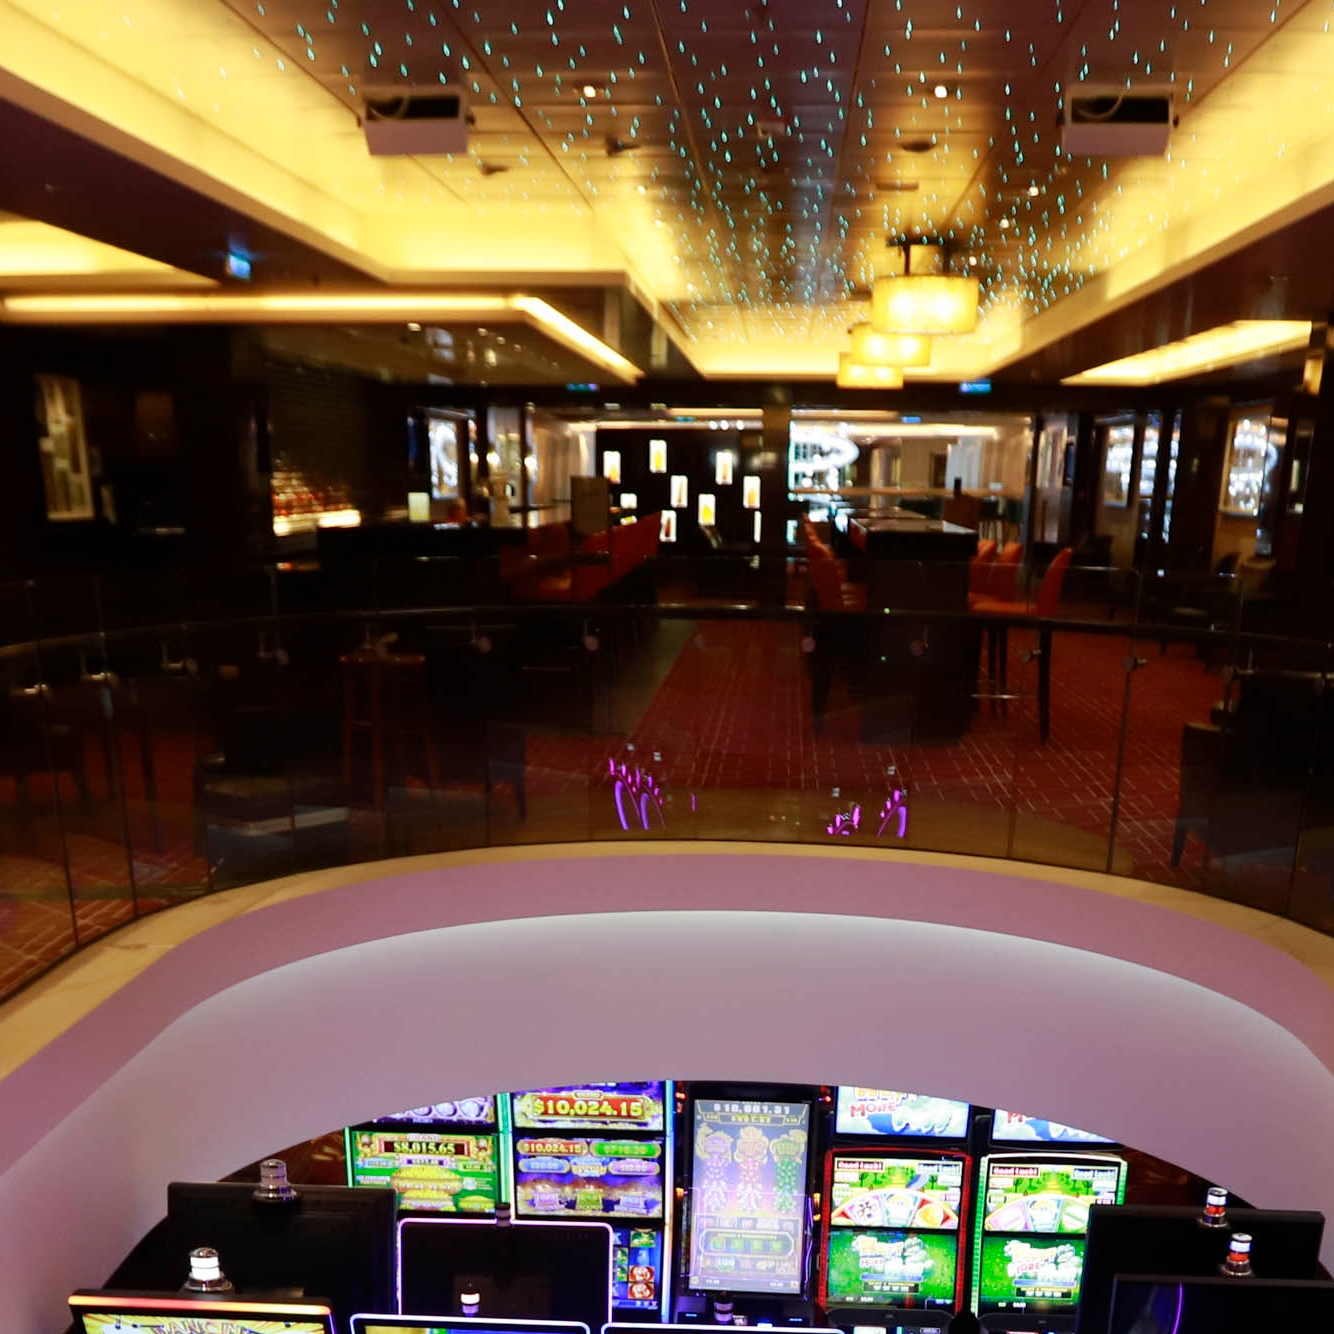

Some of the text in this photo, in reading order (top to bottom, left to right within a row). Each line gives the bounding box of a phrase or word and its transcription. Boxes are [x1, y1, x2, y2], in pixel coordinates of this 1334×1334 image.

[534, 1099, 643, 1116] $10,024.15
[393, 1141, 455, 1155] $8,015.65
[523, 1143, 582, 1153] $10,024.15
